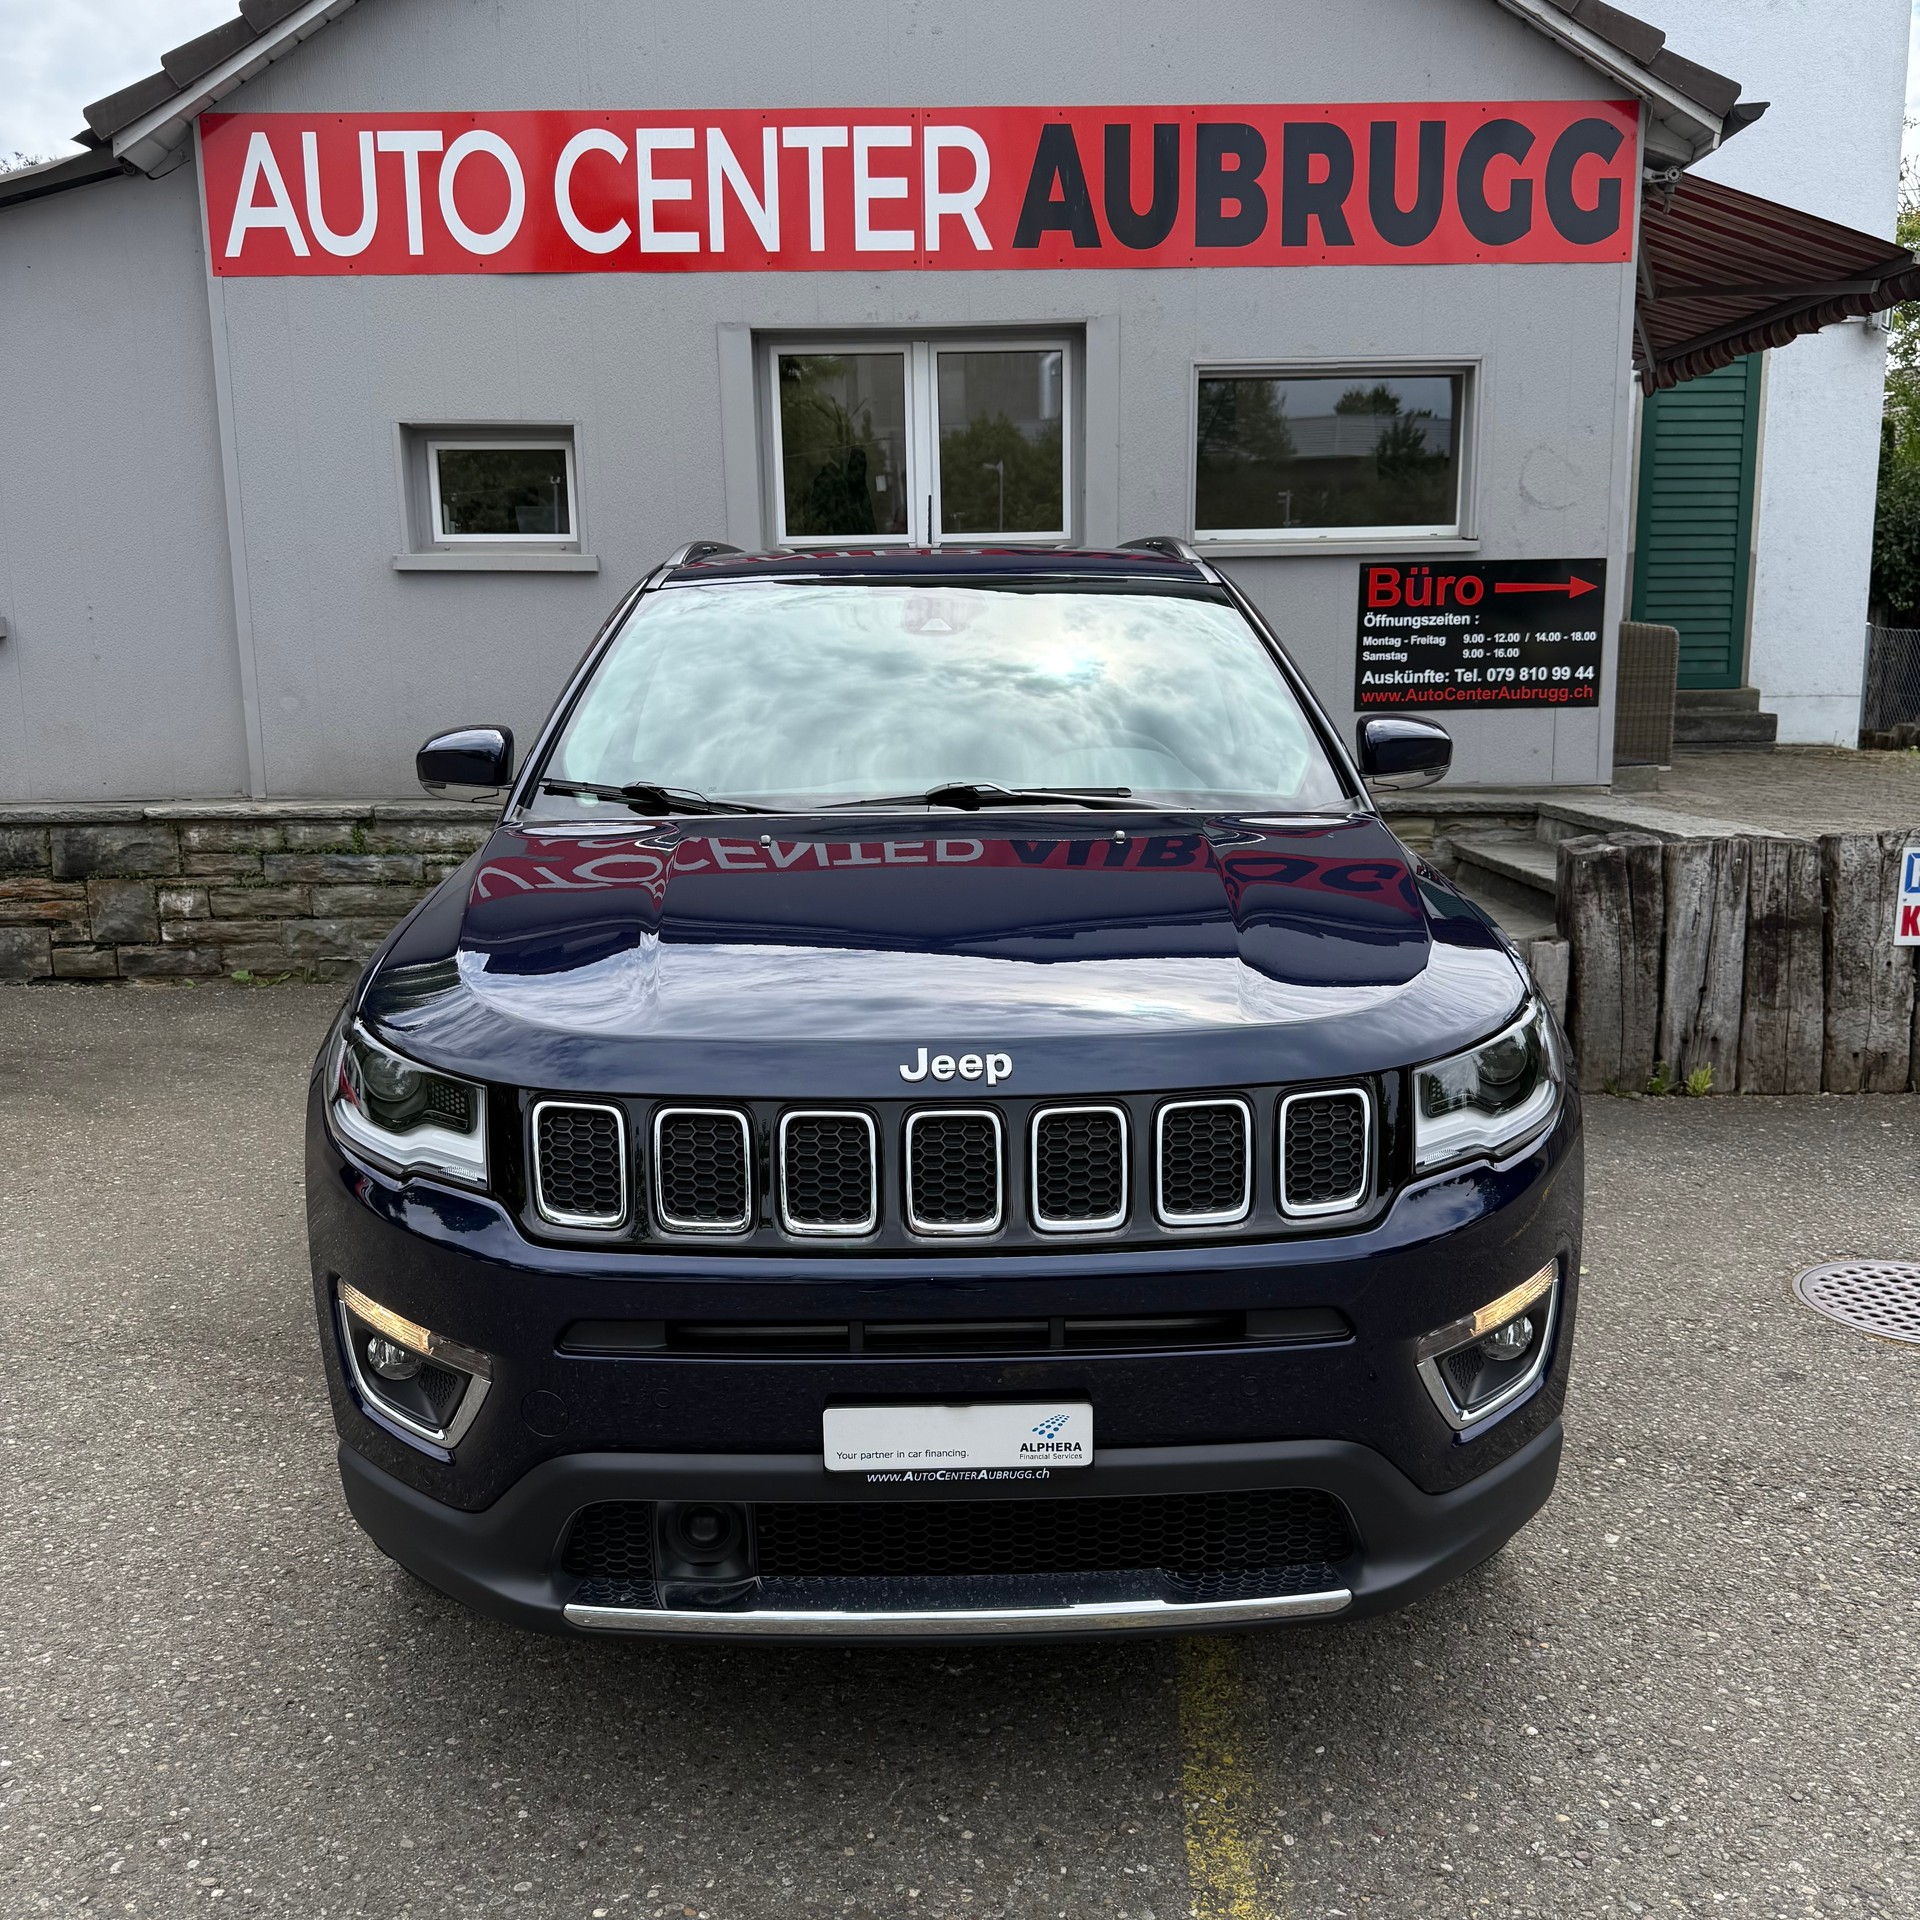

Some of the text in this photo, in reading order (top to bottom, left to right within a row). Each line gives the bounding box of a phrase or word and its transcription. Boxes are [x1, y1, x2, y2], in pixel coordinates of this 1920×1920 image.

[224, 118, 1625, 258] AUTO CENTER AUBRUGG
[1367, 567, 1484, 607] Büro
[1363, 612, 1470, 629] Öffnungszeiten
[1362, 636, 1401, 647] Montag
[1410, 634, 1446, 647] Freitag
[1462, 633, 1485, 644] 9.00
[1493, 632, 1520, 643] 12.00
[1534, 632, 1561, 642] 14.00
[1570, 631, 1597, 642] 18.00
[1362, 651, 1408, 662] Samstag
[1462, 648, 1485, 659] 9.00
[1493, 647, 1520, 658] 16.00
[1361, 665, 1595, 685] Auskünfte: Tel. 079 810 99 44
[1361, 684, 1594, 703] www.AutoCenterAubrugg.ch
[899, 1047, 1013, 1087] Jeep
[836, 1448, 970, 1460] Your partner in car financing.
[1019, 1441, 1083, 1453] ALPHERA
[1019, 1452, 1083, 1460] Financial Services
